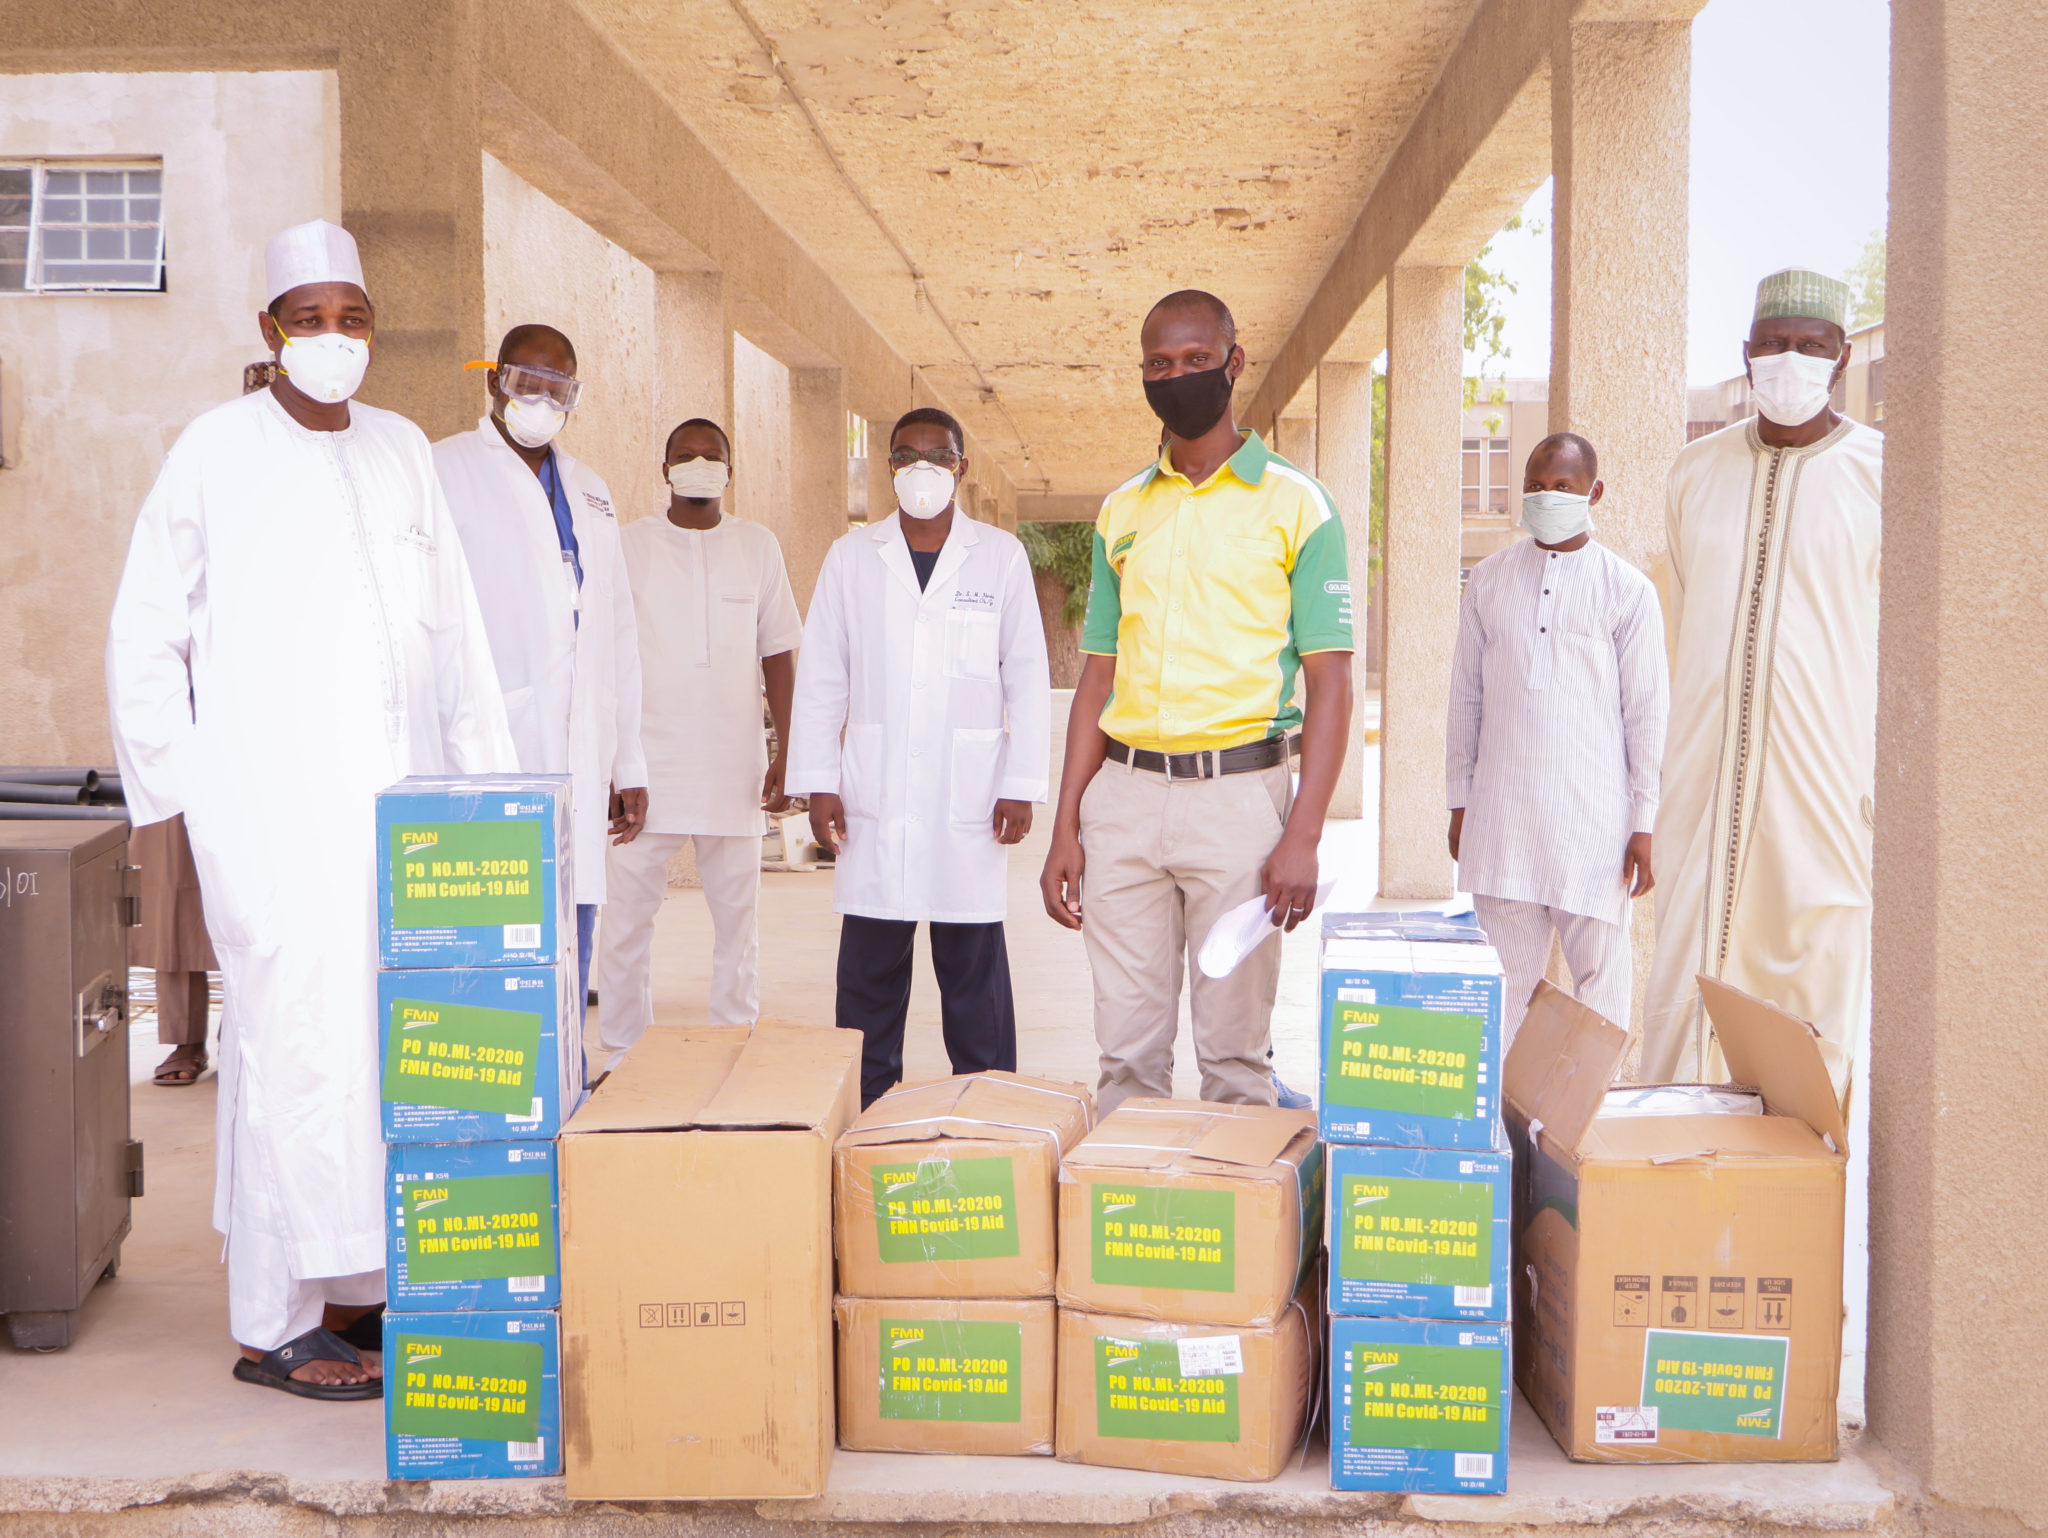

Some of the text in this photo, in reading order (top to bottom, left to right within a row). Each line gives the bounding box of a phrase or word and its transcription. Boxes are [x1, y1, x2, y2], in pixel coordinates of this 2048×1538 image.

[402, 832, 438, 844] FMN
[406, 860, 528, 878] PO NO.ML-20200
[406, 880, 529, 898] FMN Covid-19 Aid
[403, 1008, 439, 1023] FMN
[1343, 1010, 1380, 1025] FMN
[402, 1039, 524, 1066] PO NO.ML-20200
[1342, 1040, 1466, 1068] PO NO.ML-20200
[400, 1059, 521, 1086] FMN Covid-19 Aid
[1341, 1061, 1464, 1089] FMN Covid-19 Aid
[883, 1172, 916, 1184] FMN
[413, 1188, 448, 1200] FMN
[1102, 1193, 1136, 1205] FMN
[1353, 1184, 1390, 1197] FMN
[912, 1195, 1002, 1214] NO.ML-20200
[418, 1212, 538, 1234] PO NO.ML-20200
[890, 1215, 1004, 1234] FMN Covid-19 Aid
[1105, 1222, 1221, 1243] PO NO.ML-20200
[1355, 1215, 1478, 1237] PO NO.ML-20200
[419, 1232, 539, 1253] FMN Covid-19 Aid
[1354, 1235, 1477, 1258] FMN Covid-19 Aid
[1105, 1242, 1222, 1263] FMN Covid-19 Aid
[891, 1328, 924, 1338] FMN
[407, 1344, 442, 1356] FMN
[1105, 1346, 1139, 1358] FMN
[1363, 1352, 1399, 1364] FMN
[893, 1357, 1008, 1374] PO NO.ML-20200
[1656, 1360, 1774, 1381] FMN Covid-19 Aid
[407, 1373, 527, 1394] PO NO.ML-20200
[893, 1377, 1008, 1393] FMN Covid-19 Aid
[1110, 1375, 1224, 1394] PO NO.ML-20200
[1365, 1382, 1487, 1402] PO NO.ML-20200
[1655, 1379, 1772, 1400] PO NO.ML-20200
[406, 1392, 525, 1413] FMN Covid-19 Aid
[1110, 1395, 1226, 1414] FMN Covid-19 Aid
[1365, 1402, 1487, 1422] FMN Covid-19 Aid
[1736, 1416, 1771, 1428] FMN
